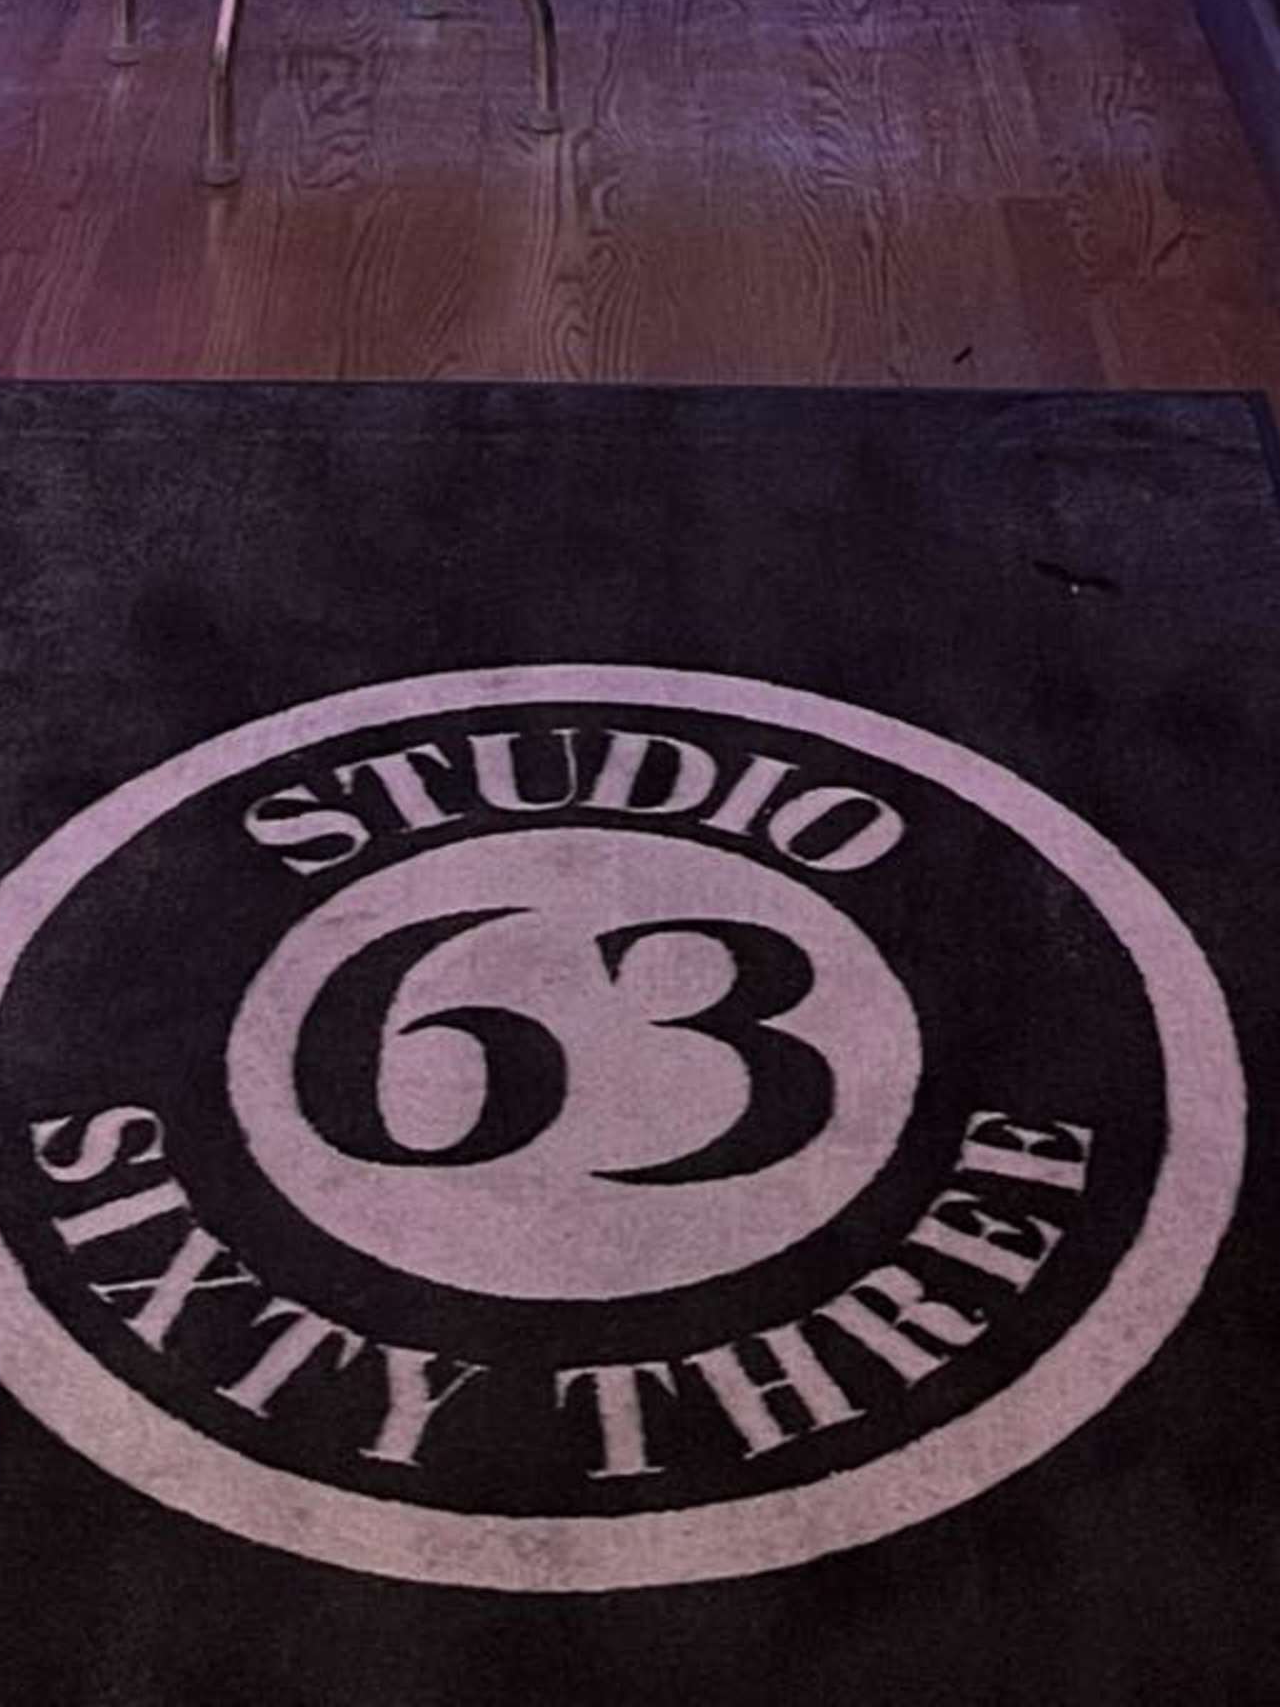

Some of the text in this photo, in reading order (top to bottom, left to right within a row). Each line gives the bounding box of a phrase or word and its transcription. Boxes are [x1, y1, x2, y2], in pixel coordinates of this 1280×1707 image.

[243, 727, 907, 875] STUDIO
[291, 905, 837, 1187] 63
[29, 1104, 1095, 1479] SIXTY THREE
